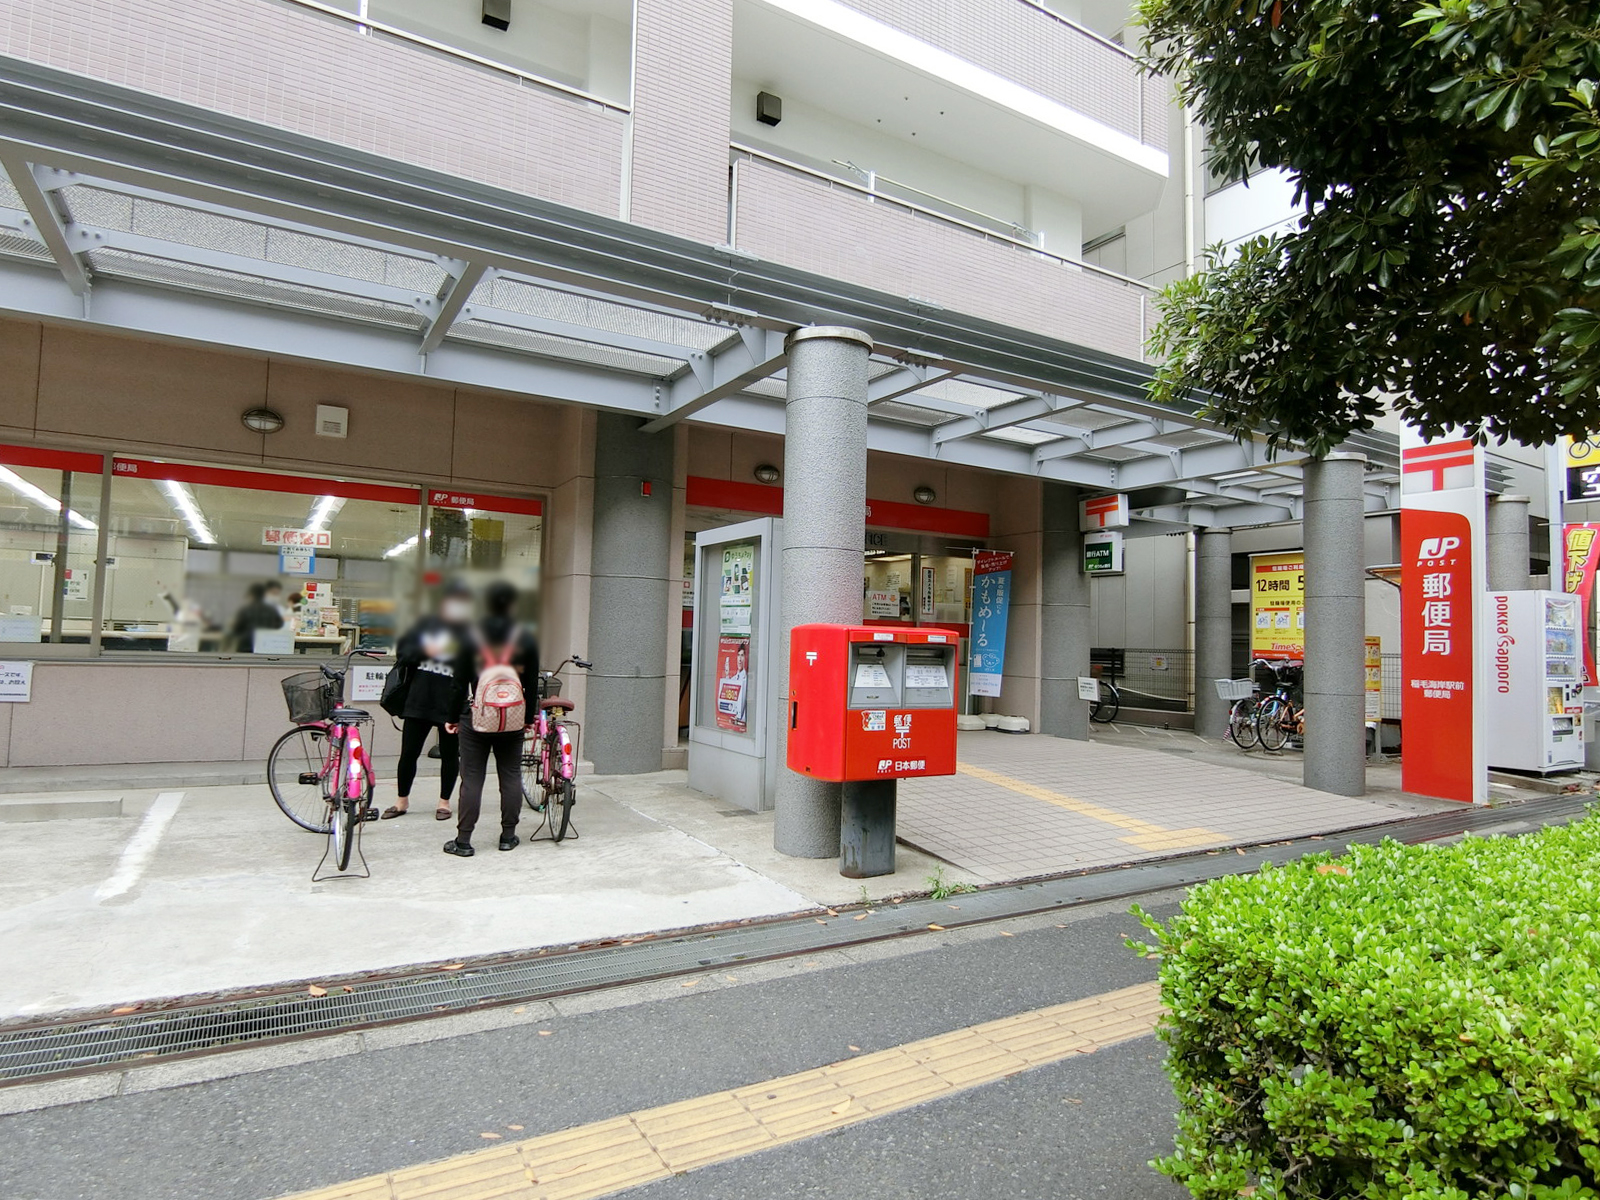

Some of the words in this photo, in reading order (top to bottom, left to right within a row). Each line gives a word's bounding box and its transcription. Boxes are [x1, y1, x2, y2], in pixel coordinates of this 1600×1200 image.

[451, 496, 475, 505] 郵便局
[1419, 536, 1460, 559] JP
[1086, 549, 1110, 558] 銀行ATM
[1416, 559, 1457, 567] POST
[1566, 529, 1596, 594] 値下げ
[1255, 579, 1290, 592] 12時間
[1421, 573, 1451, 655] 郵便局
[1410, 679, 1465, 691] 稲毛海岸駅前
[1423, 689, 1451, 699] 郵便局
[893, 714, 912, 727] 郵便
[892, 738, 911, 749] POST
[895, 760, 926, 771] 日本郵便
